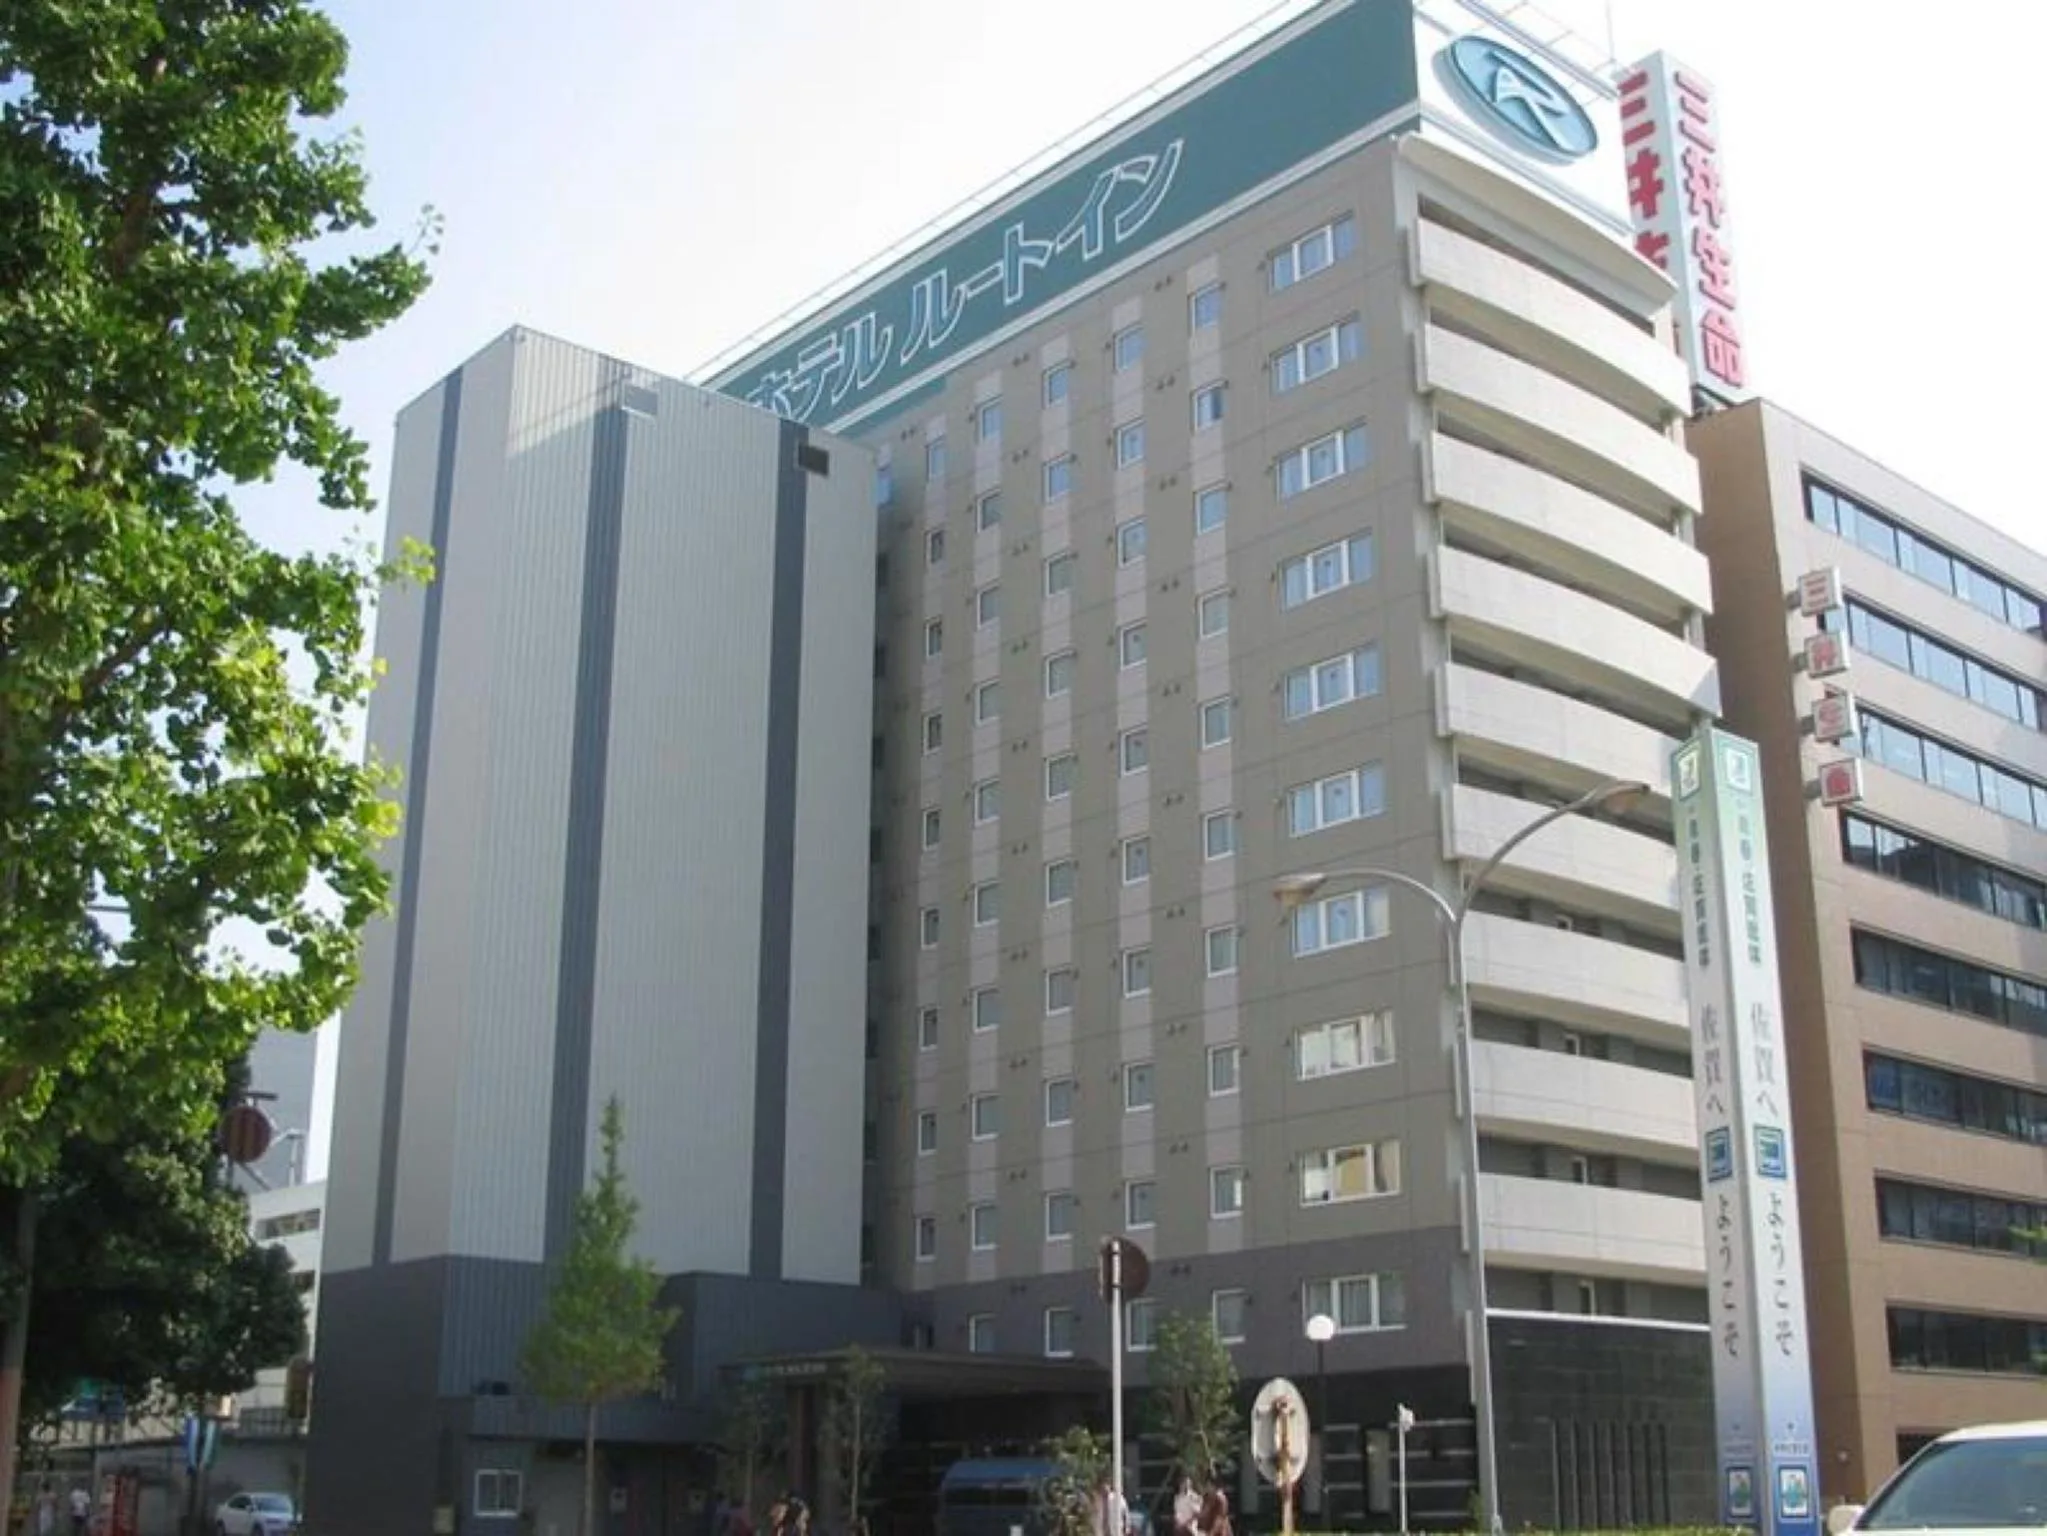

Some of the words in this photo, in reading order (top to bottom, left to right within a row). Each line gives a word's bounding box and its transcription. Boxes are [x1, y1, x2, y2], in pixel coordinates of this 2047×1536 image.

[900, 138, 1183, 366] ルートイン
[1674, 71, 1745, 388] 三井生命
[1716, 1193, 1741, 1358] ようこそ
[1767, 1192, 1796, 1357] ようこそ
